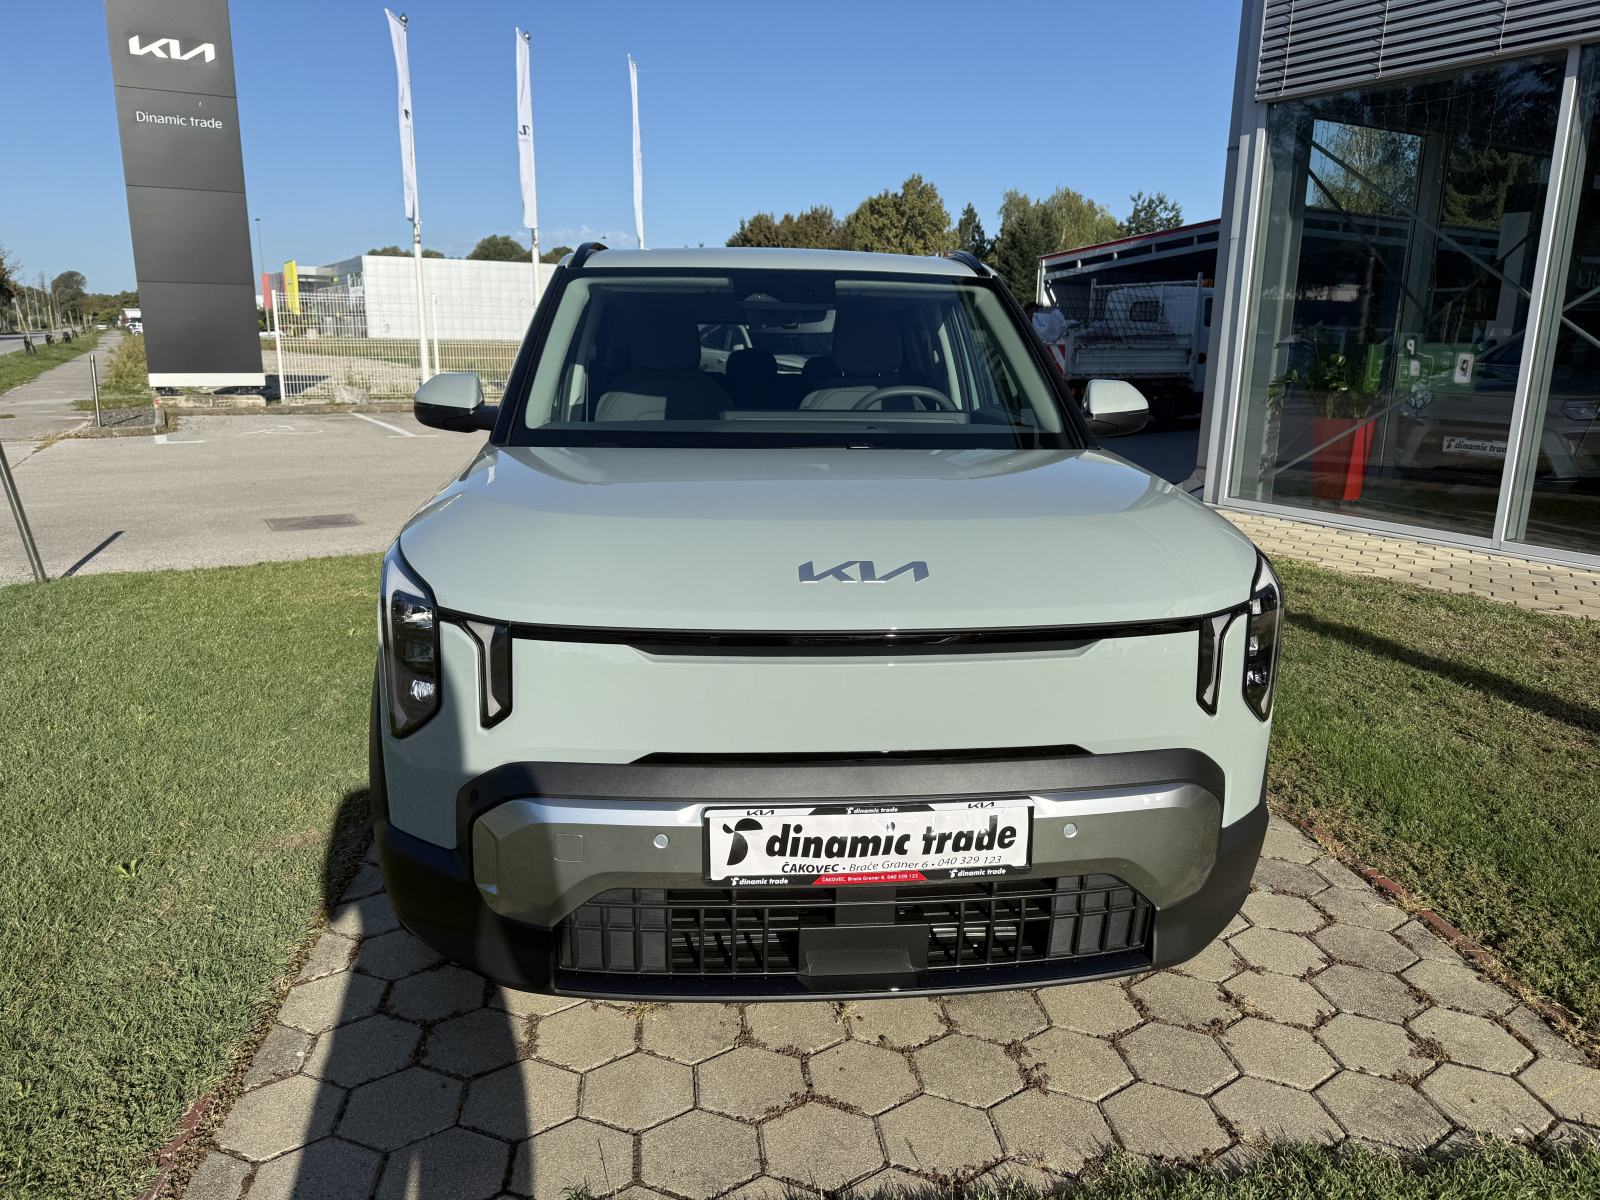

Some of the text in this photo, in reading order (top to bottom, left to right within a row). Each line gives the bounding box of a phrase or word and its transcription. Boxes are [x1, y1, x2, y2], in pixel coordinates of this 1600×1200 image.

[128, 34, 216, 63] KIA
[135, 110, 223, 129] Dinamic trade
[1489, 444, 1508, 454] trad
[798, 560, 929, 583] KIA
[853, 807, 879, 815] dinamic
[968, 801, 995, 809] KIA
[766, 815, 1017, 859] dinamic trade
[782, 862, 840, 874] ČAKOVEC
[882, 860, 920, 870] Graner
[937, 857, 958, 867] 040
[960, 856, 980, 865] 329
[984, 855, 1002, 864] 123
[957, 869, 985, 877] dinamic
